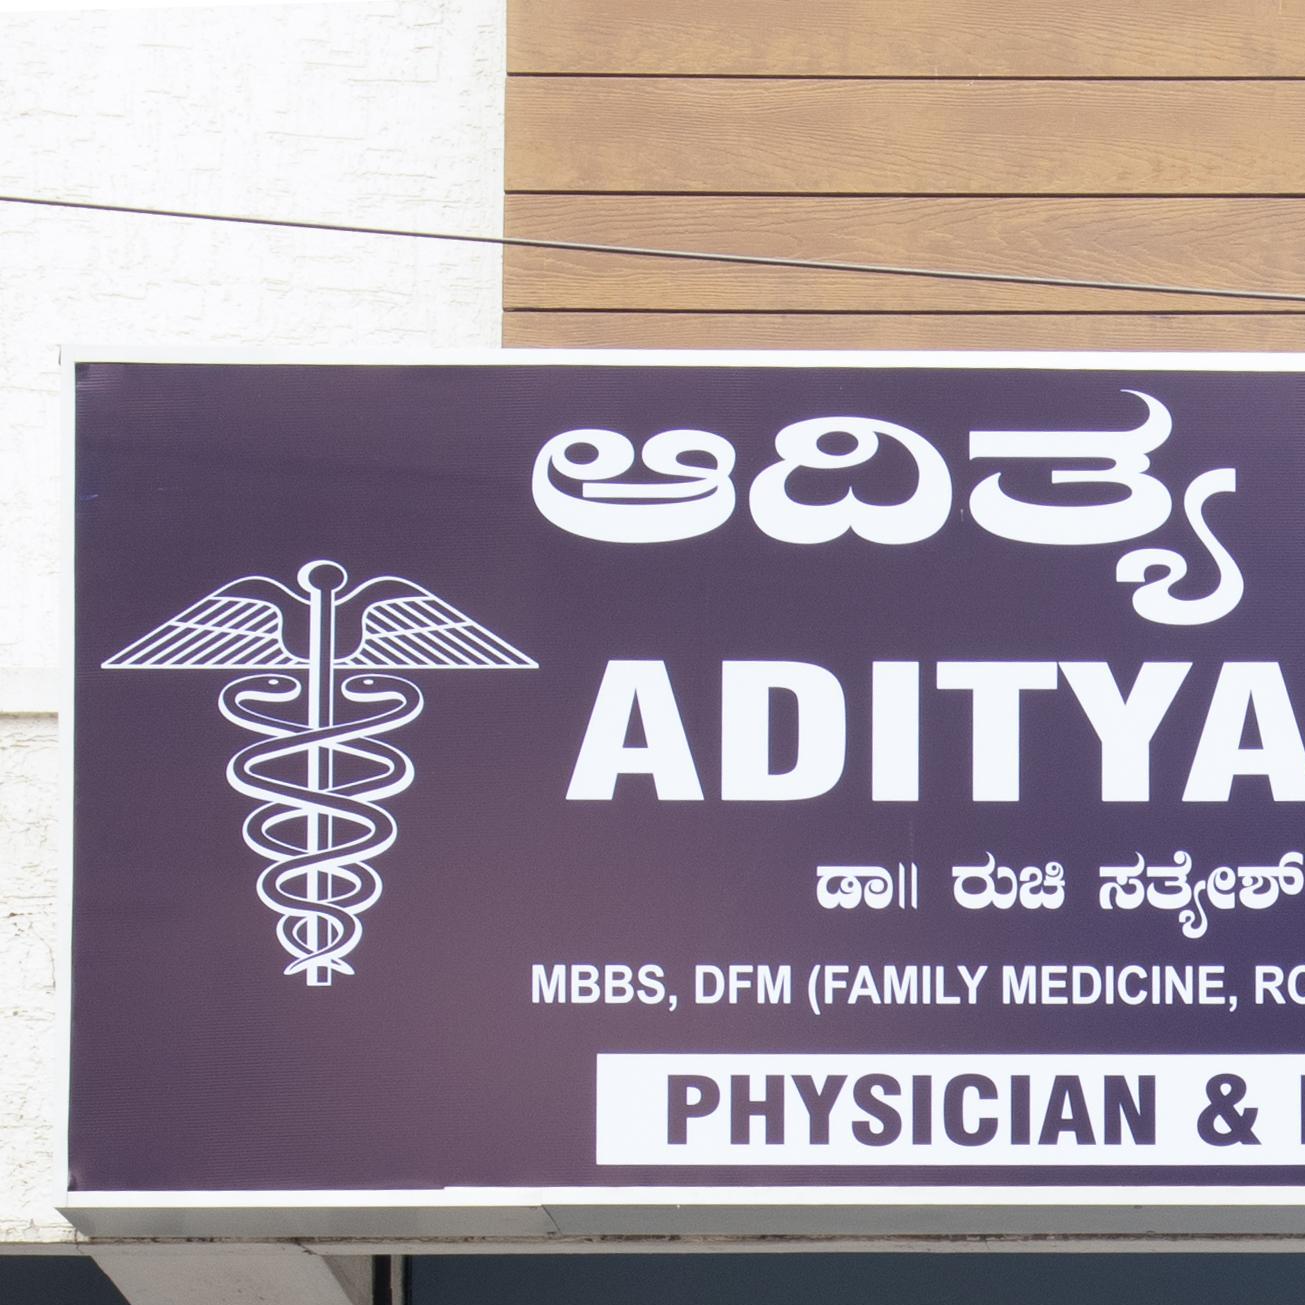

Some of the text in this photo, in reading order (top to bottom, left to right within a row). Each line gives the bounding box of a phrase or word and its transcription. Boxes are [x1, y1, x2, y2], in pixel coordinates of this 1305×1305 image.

[532, 390, 1244, 625] ಆದಿತ್ಯ
[952, 852, 1065, 909] ರುಚಿ
[1100, 851, 1304, 938] ಸತ್ಯೇಶ್
[532, 965, 677, 1011] MBBS,
[696, 965, 791, 1003] DFM
[808, 965, 987, 1015] (FAMILY
[1003, 965, 1237, 1012] MEDICINE,
[668, 1074, 1155, 1146] PHYSICIAN
[1197, 1074, 1261, 1146] &
